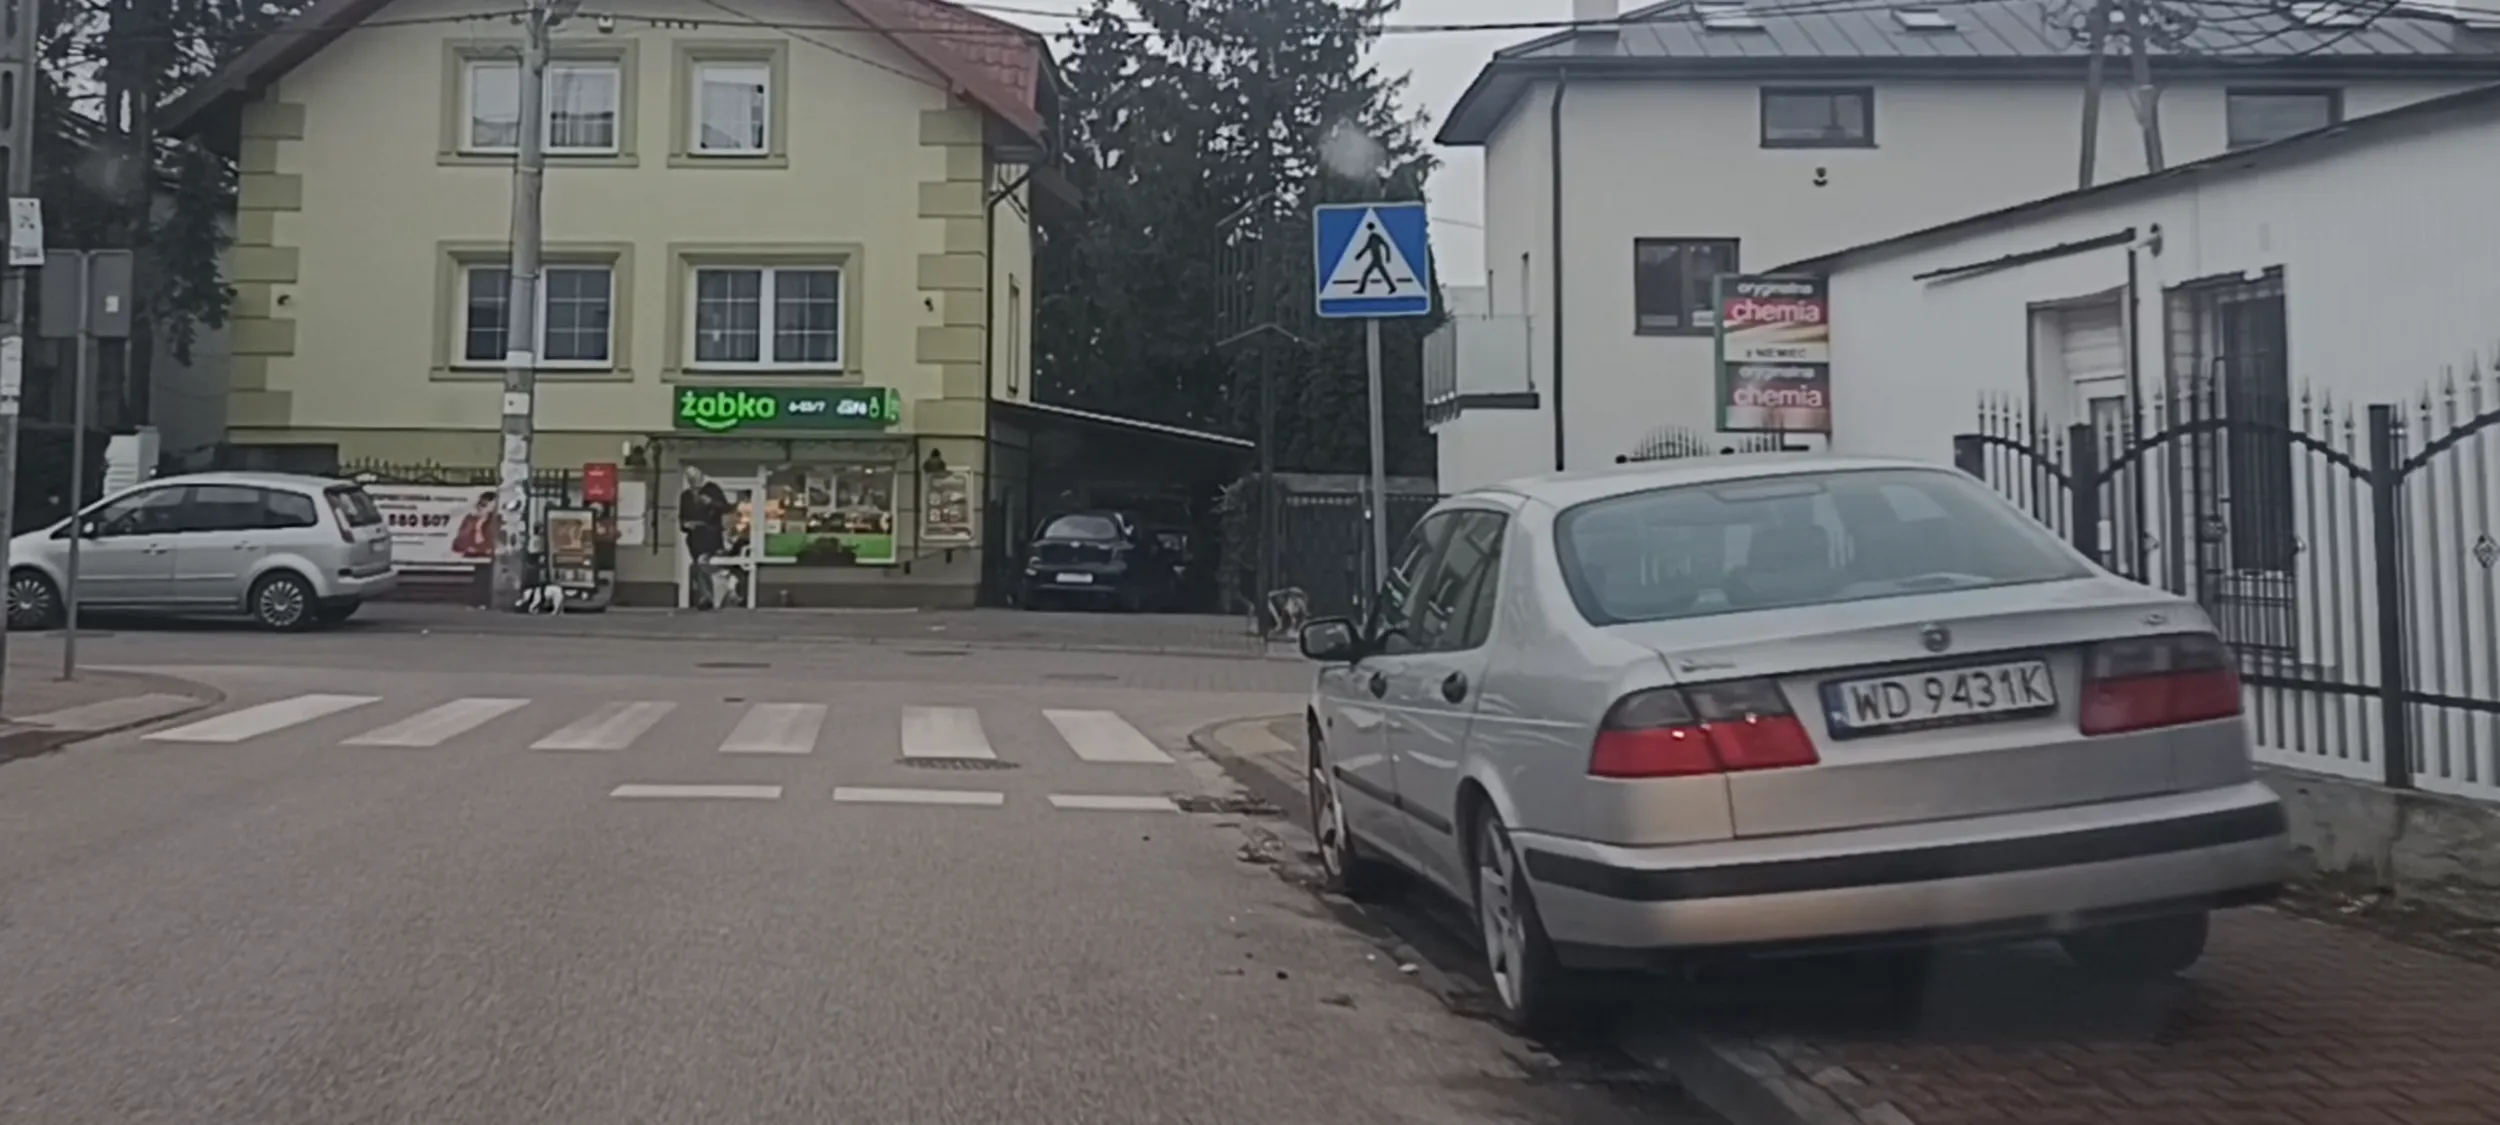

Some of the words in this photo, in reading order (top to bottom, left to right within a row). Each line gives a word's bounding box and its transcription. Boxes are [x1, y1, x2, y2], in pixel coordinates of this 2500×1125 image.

[1732, 300, 1821, 321] chemia
[681, 390, 776, 418] żabka
[1733, 385, 1823, 406] chemia
[1852, 681, 1911, 722] WD
[1923, 665, 2047, 714] 9431K
